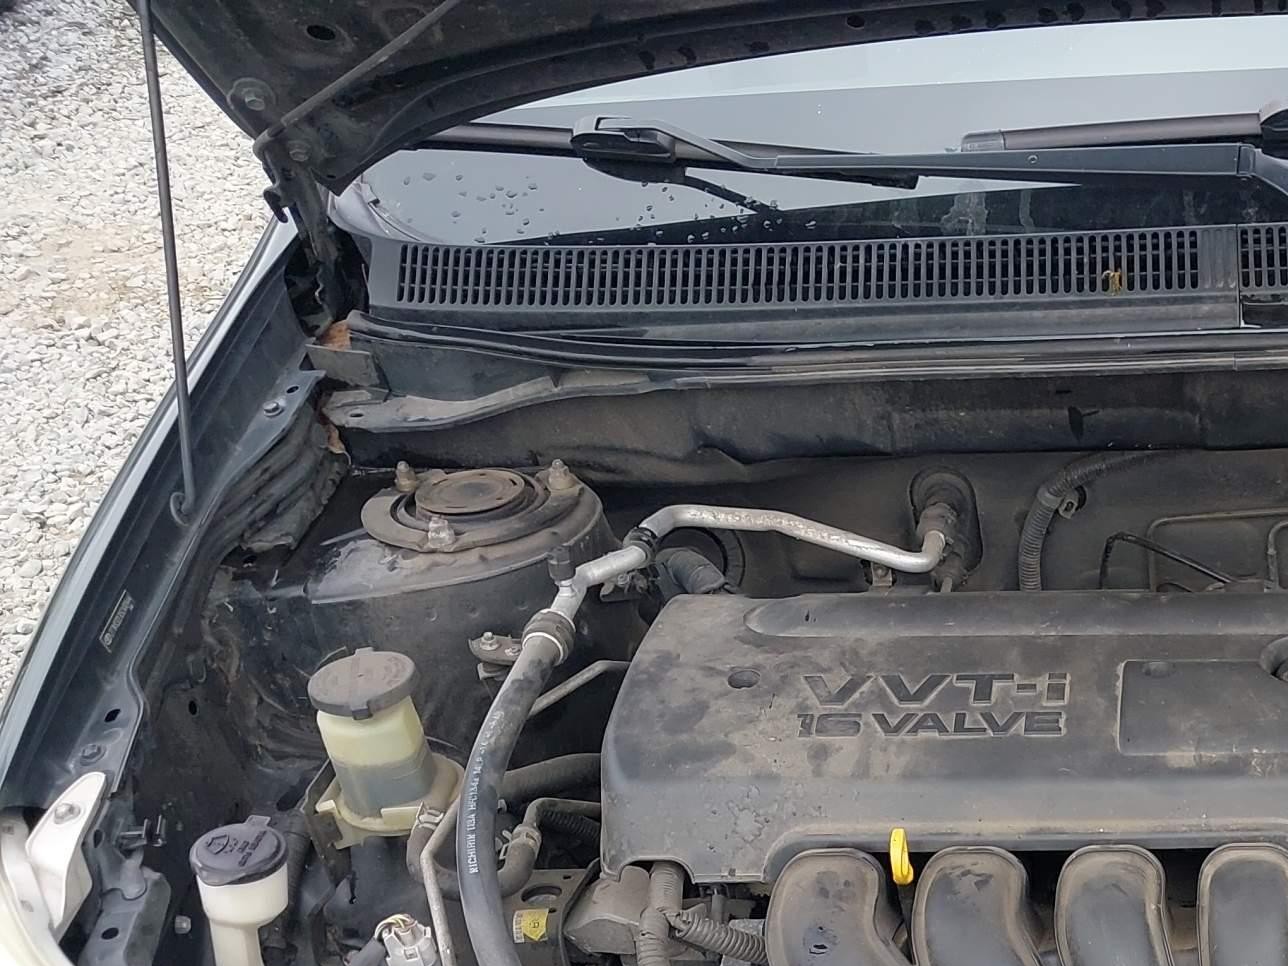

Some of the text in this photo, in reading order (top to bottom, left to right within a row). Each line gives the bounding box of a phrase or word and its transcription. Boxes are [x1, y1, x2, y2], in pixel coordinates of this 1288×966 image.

[801, 672, 1071, 707] VVT-i
[797, 711, 1068, 737] 16 VALVE
